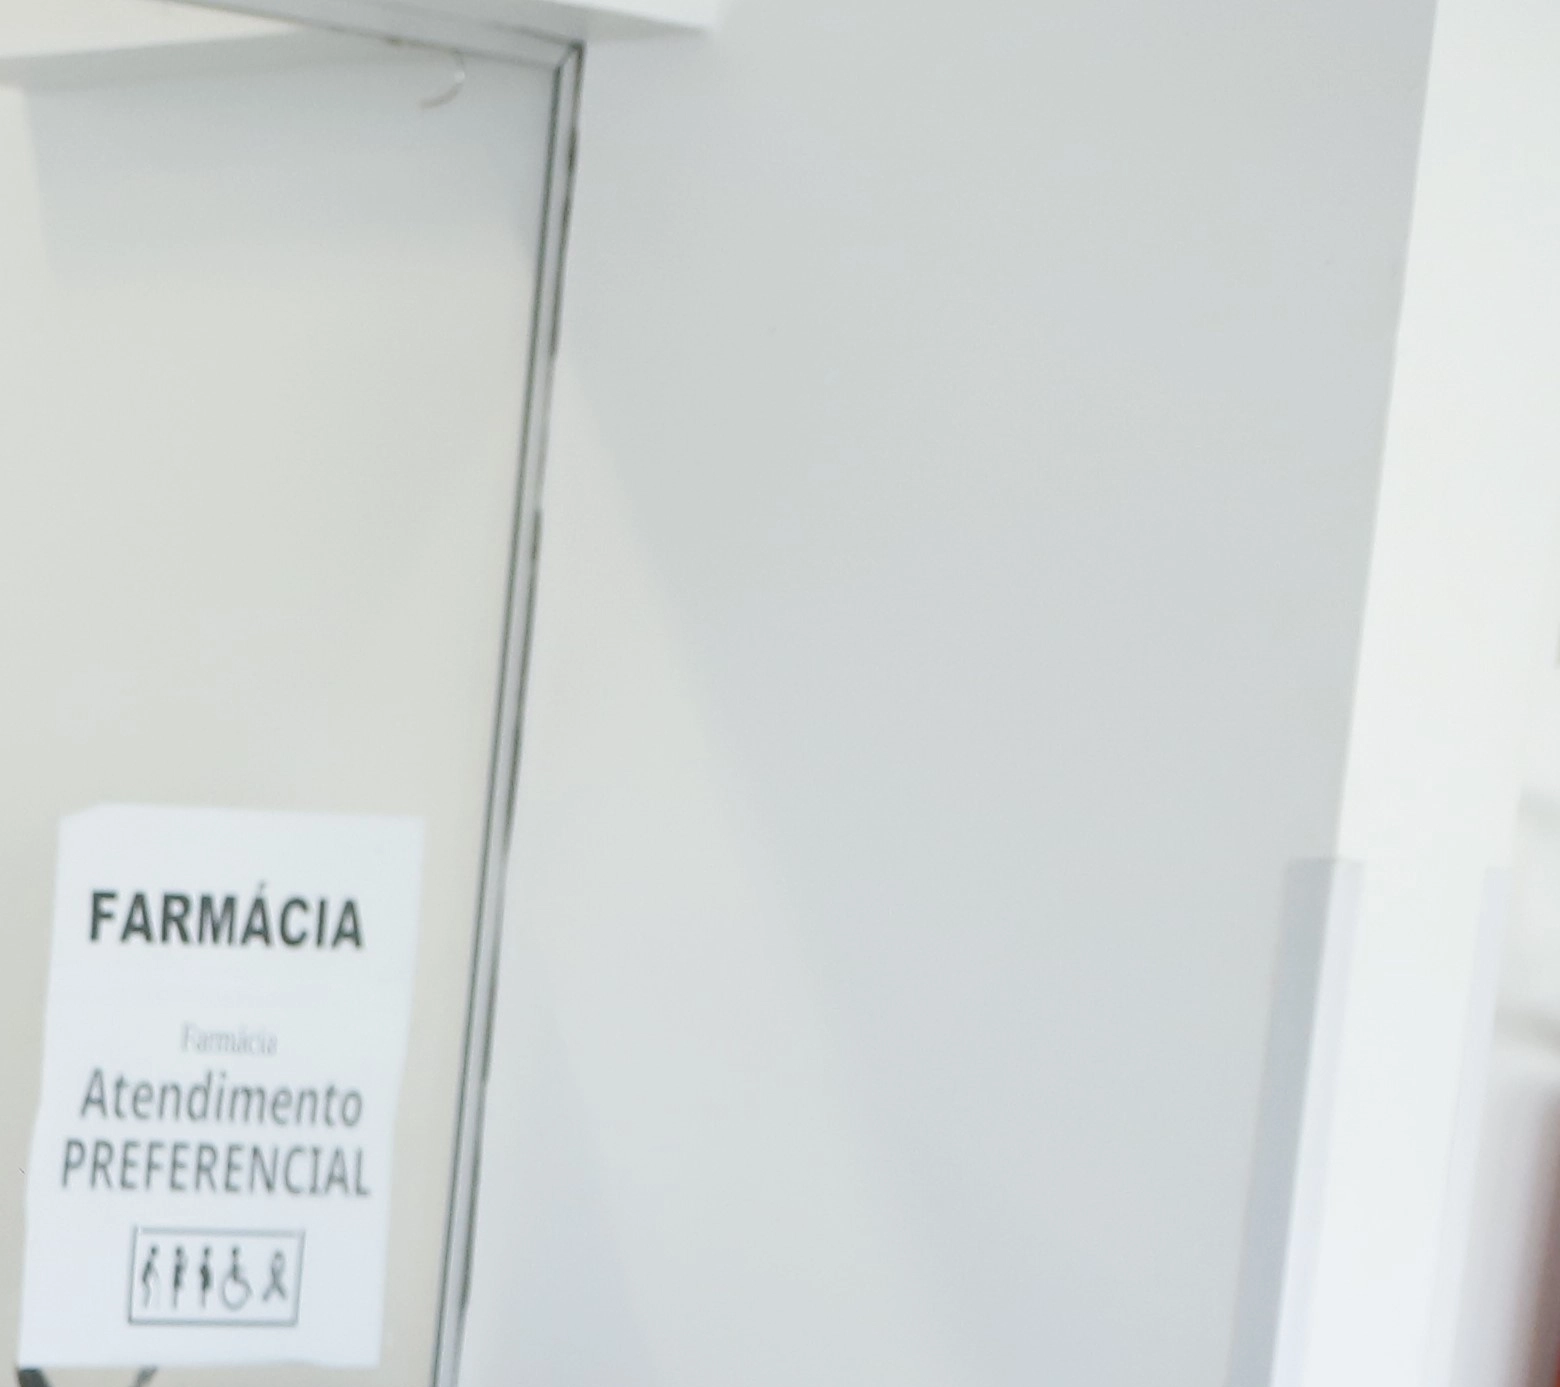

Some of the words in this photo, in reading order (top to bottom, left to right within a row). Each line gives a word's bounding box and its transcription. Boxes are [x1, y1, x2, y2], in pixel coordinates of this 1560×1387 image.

[87, 880, 366, 951] FARMÁCIA
[179, 1021, 278, 1056] Farmácia
[79, 1066, 365, 1128] Atendimento
[60, 1137, 372, 1198] PREFERENCIAL
